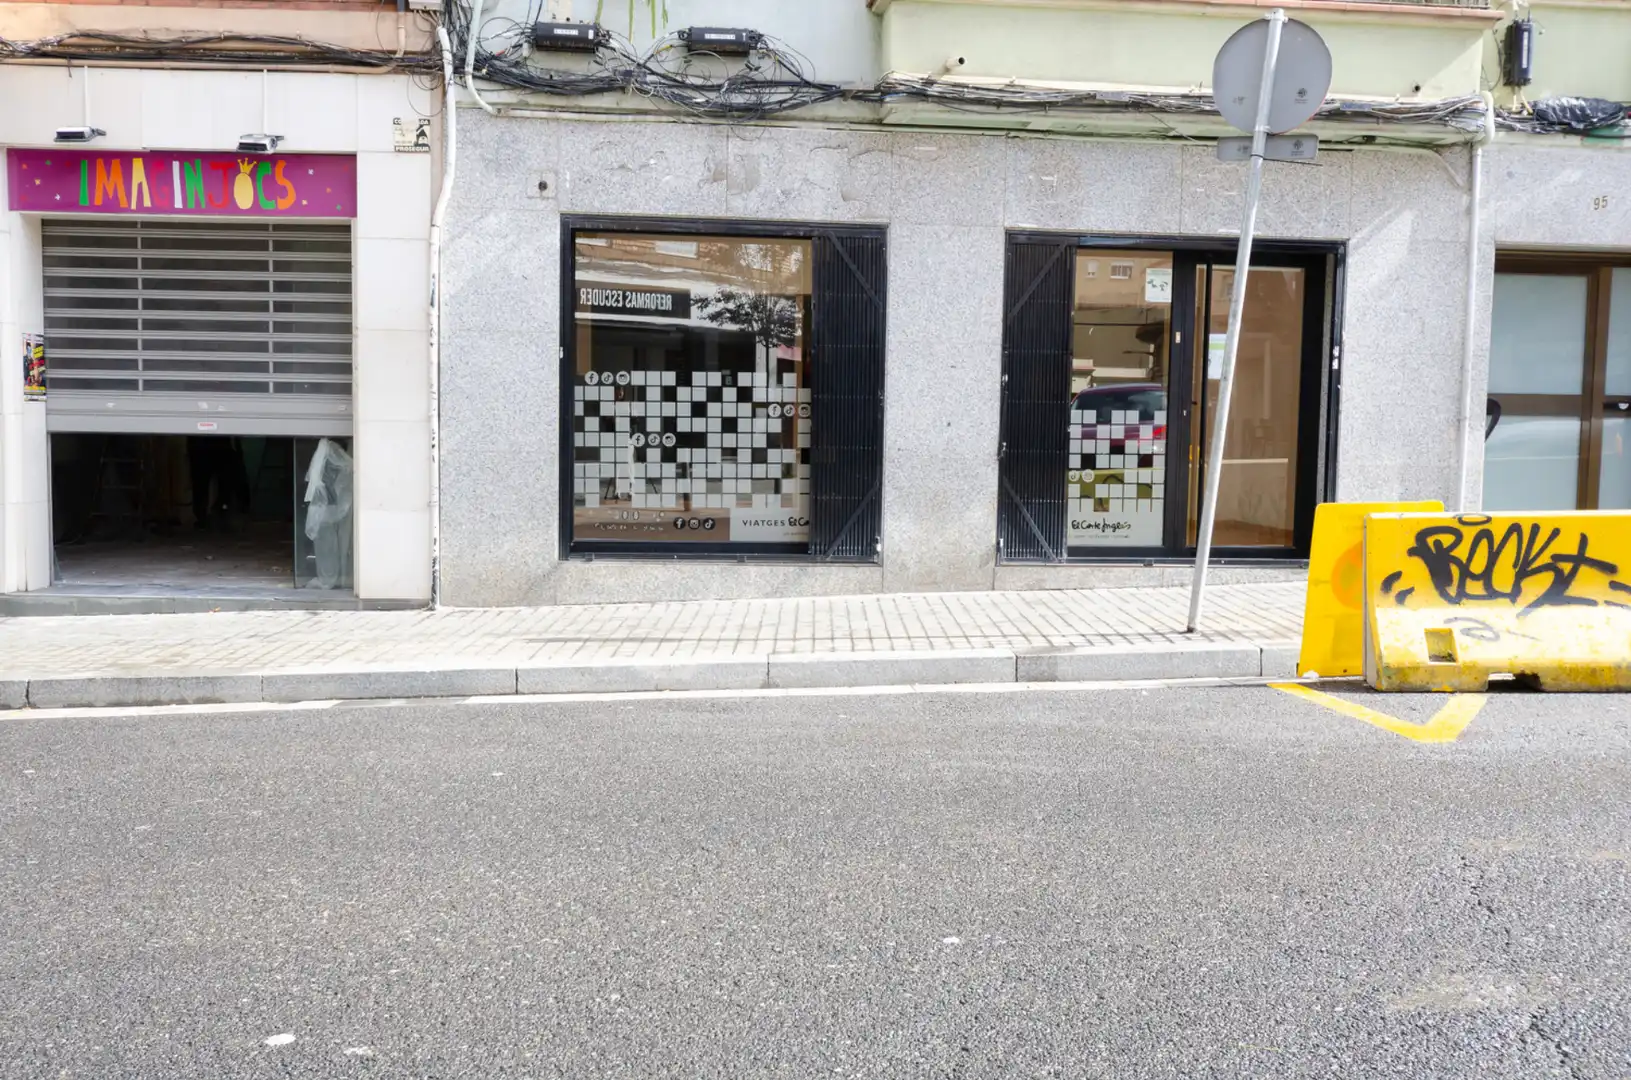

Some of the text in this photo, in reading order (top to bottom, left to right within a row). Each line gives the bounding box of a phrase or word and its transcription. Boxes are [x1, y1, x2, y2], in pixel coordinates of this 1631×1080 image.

[78, 157, 296, 211] IMAGINJOCS
[1593, 195, 1608, 211] 95
[742, 519, 786, 527] VIATGES
